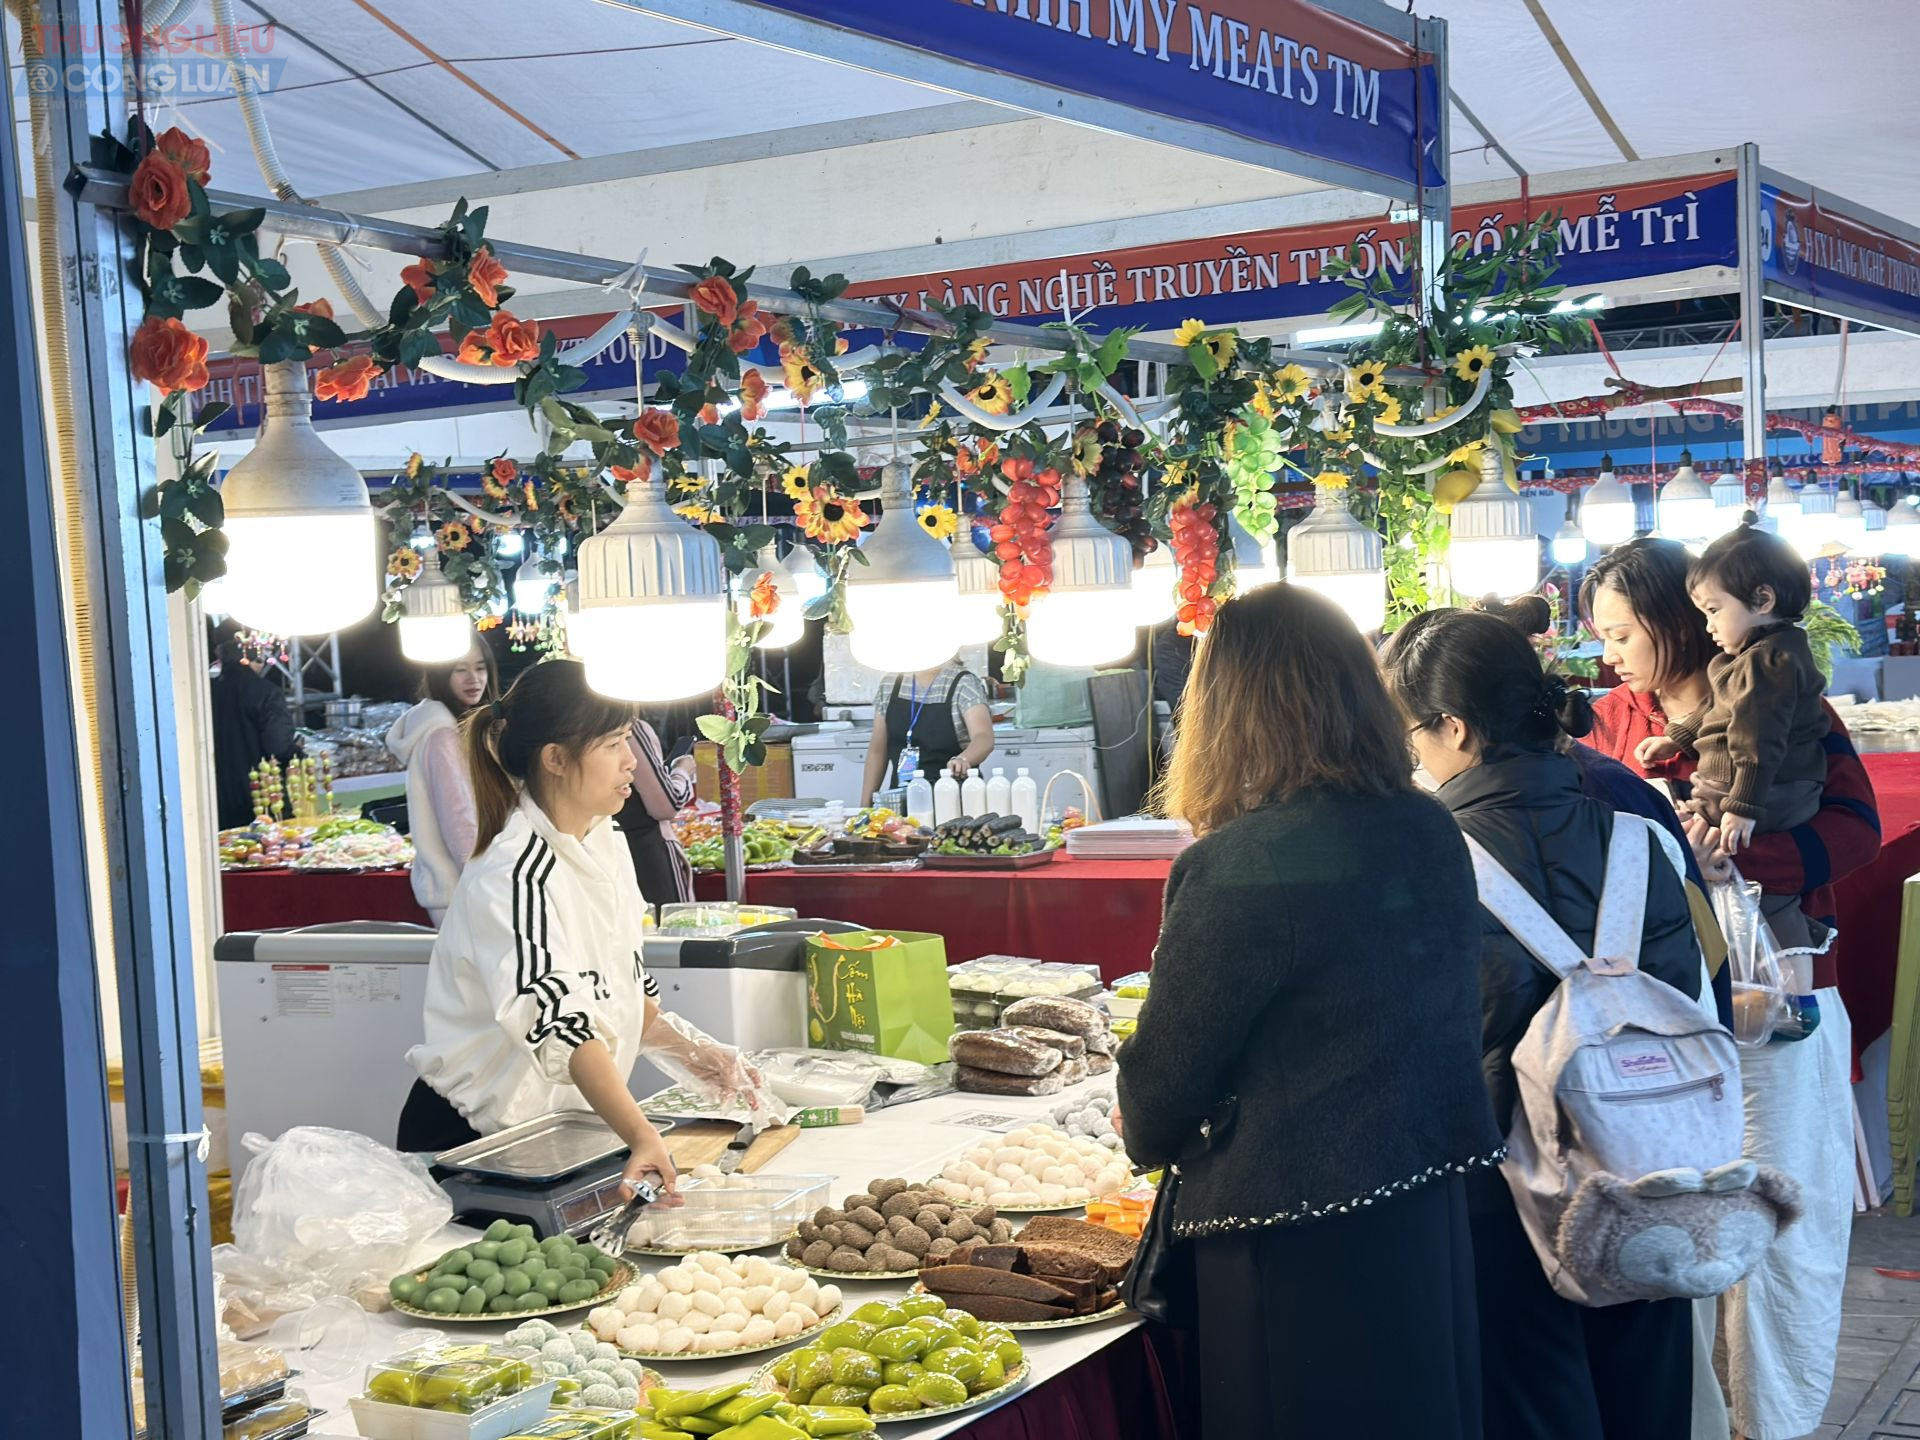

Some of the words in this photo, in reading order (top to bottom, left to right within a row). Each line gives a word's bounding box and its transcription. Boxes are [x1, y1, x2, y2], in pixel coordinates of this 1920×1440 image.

[1187, 5, 1319, 106] MEATS
[1327, 54, 1380, 126] TM
[1018, 260, 1118, 314] NGHỀ
[1126, 245, 1280, 303] TRUYỀN
[1290, 229, 1420, 286] THỐN
[1555, 194, 1620, 256] MỄ
[836, 960, 869, 979] Cốm
[846, 982, 863, 1003] Hà
